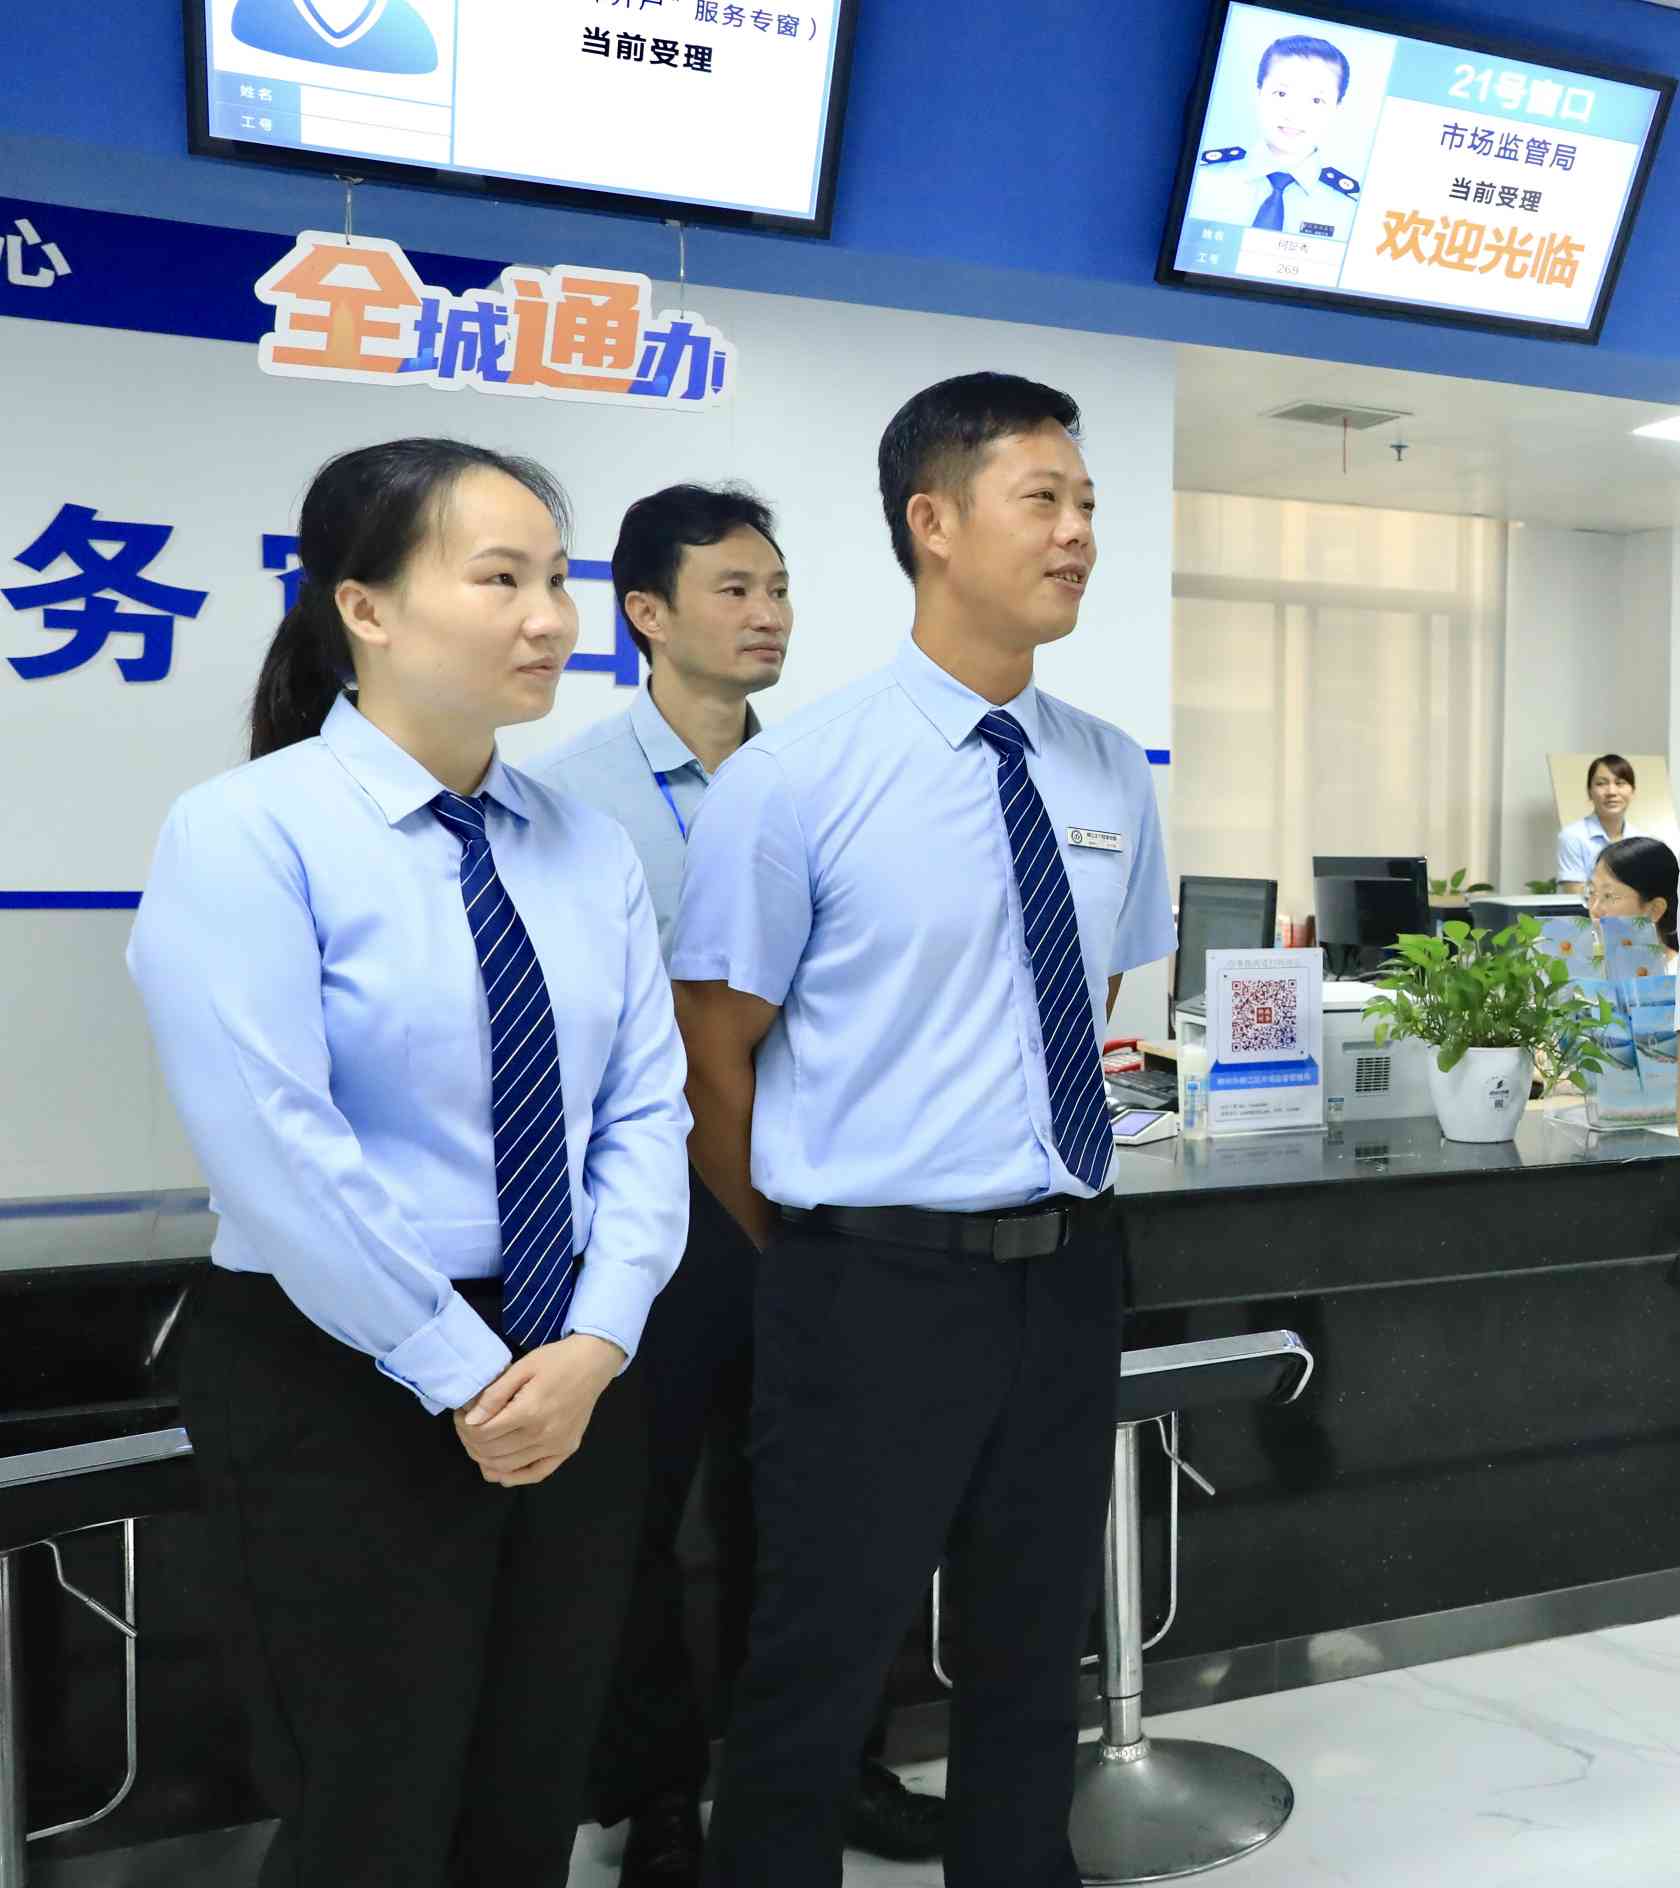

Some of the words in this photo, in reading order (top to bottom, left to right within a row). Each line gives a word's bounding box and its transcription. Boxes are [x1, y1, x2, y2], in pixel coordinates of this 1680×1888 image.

[581, 26, 713, 73] 当前受理
[1448, 64, 1596, 123] 21号窗口
[1440, 122, 1577, 171] 市场监管局
[1448, 176, 1542, 213] 当前受理
[1376, 209, 1585, 289] 欢迎光临
[269, 243, 727, 401] 全城通办
